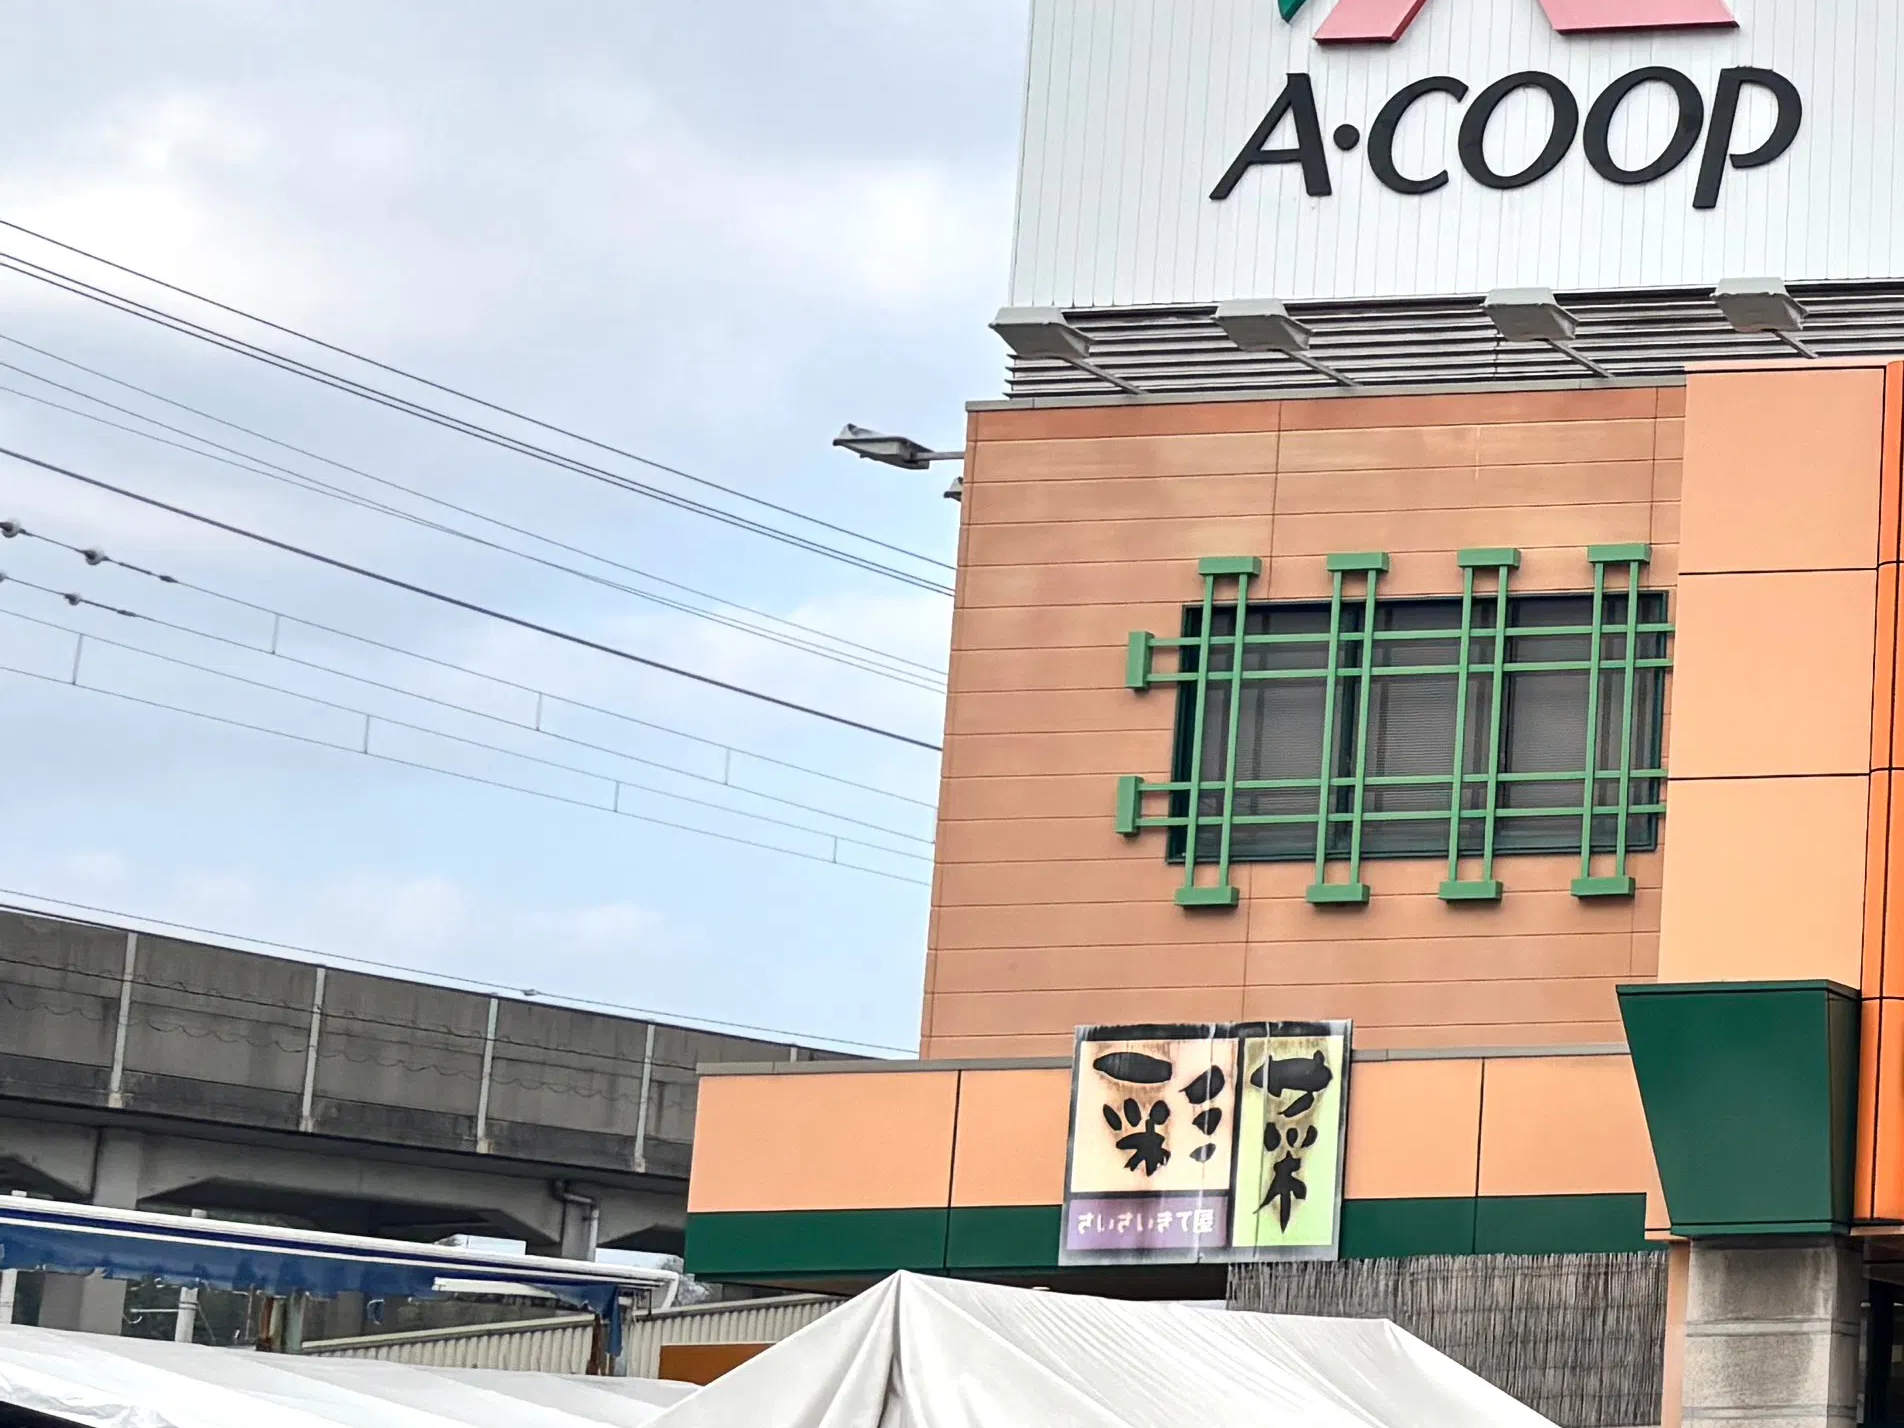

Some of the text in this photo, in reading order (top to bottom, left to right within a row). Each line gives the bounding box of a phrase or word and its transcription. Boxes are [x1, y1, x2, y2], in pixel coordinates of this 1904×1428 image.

[1077, 1208, 1214, 1234] さいさいきて屋
